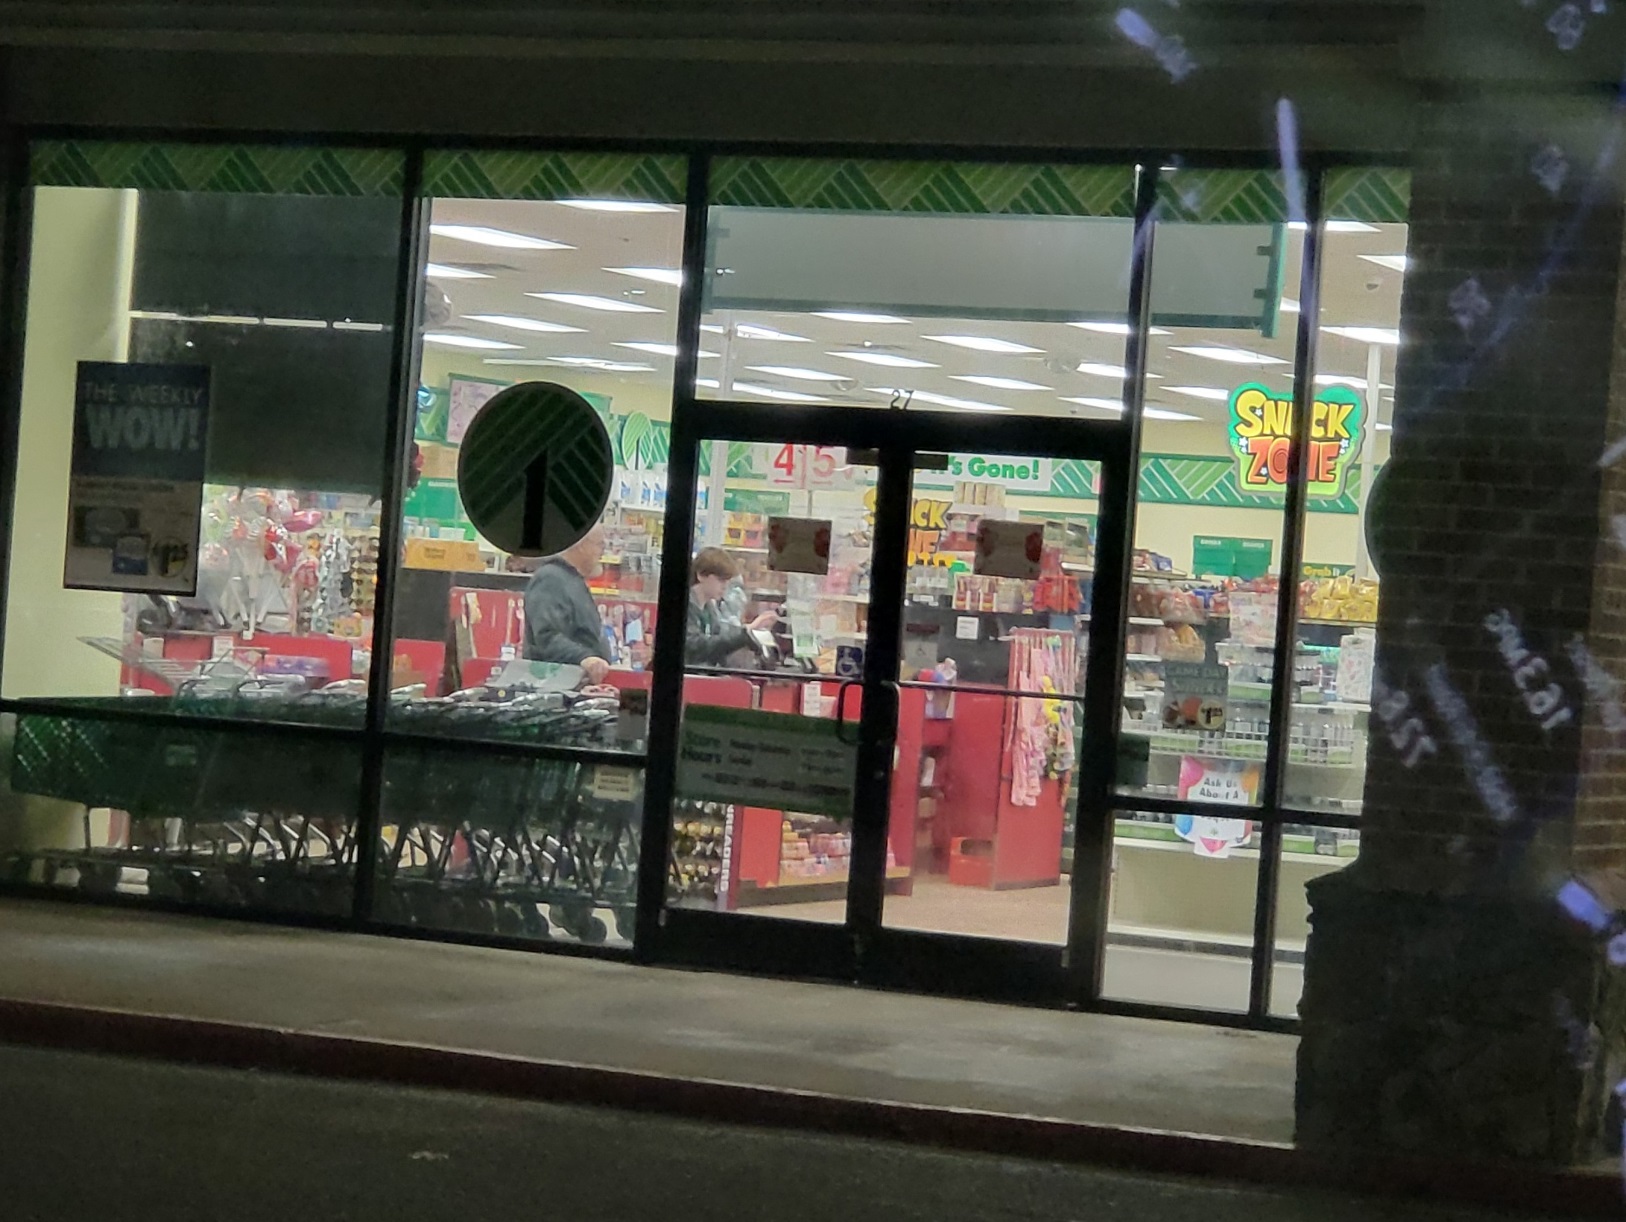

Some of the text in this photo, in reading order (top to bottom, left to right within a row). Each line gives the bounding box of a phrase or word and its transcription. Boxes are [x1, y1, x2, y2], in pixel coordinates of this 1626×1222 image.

[890, 389, 914, 410] 27
[1234, 390, 1355, 438] SNCK
[84, 403, 201, 450] WOW!
[967, 456, 1040, 480] Gone!
